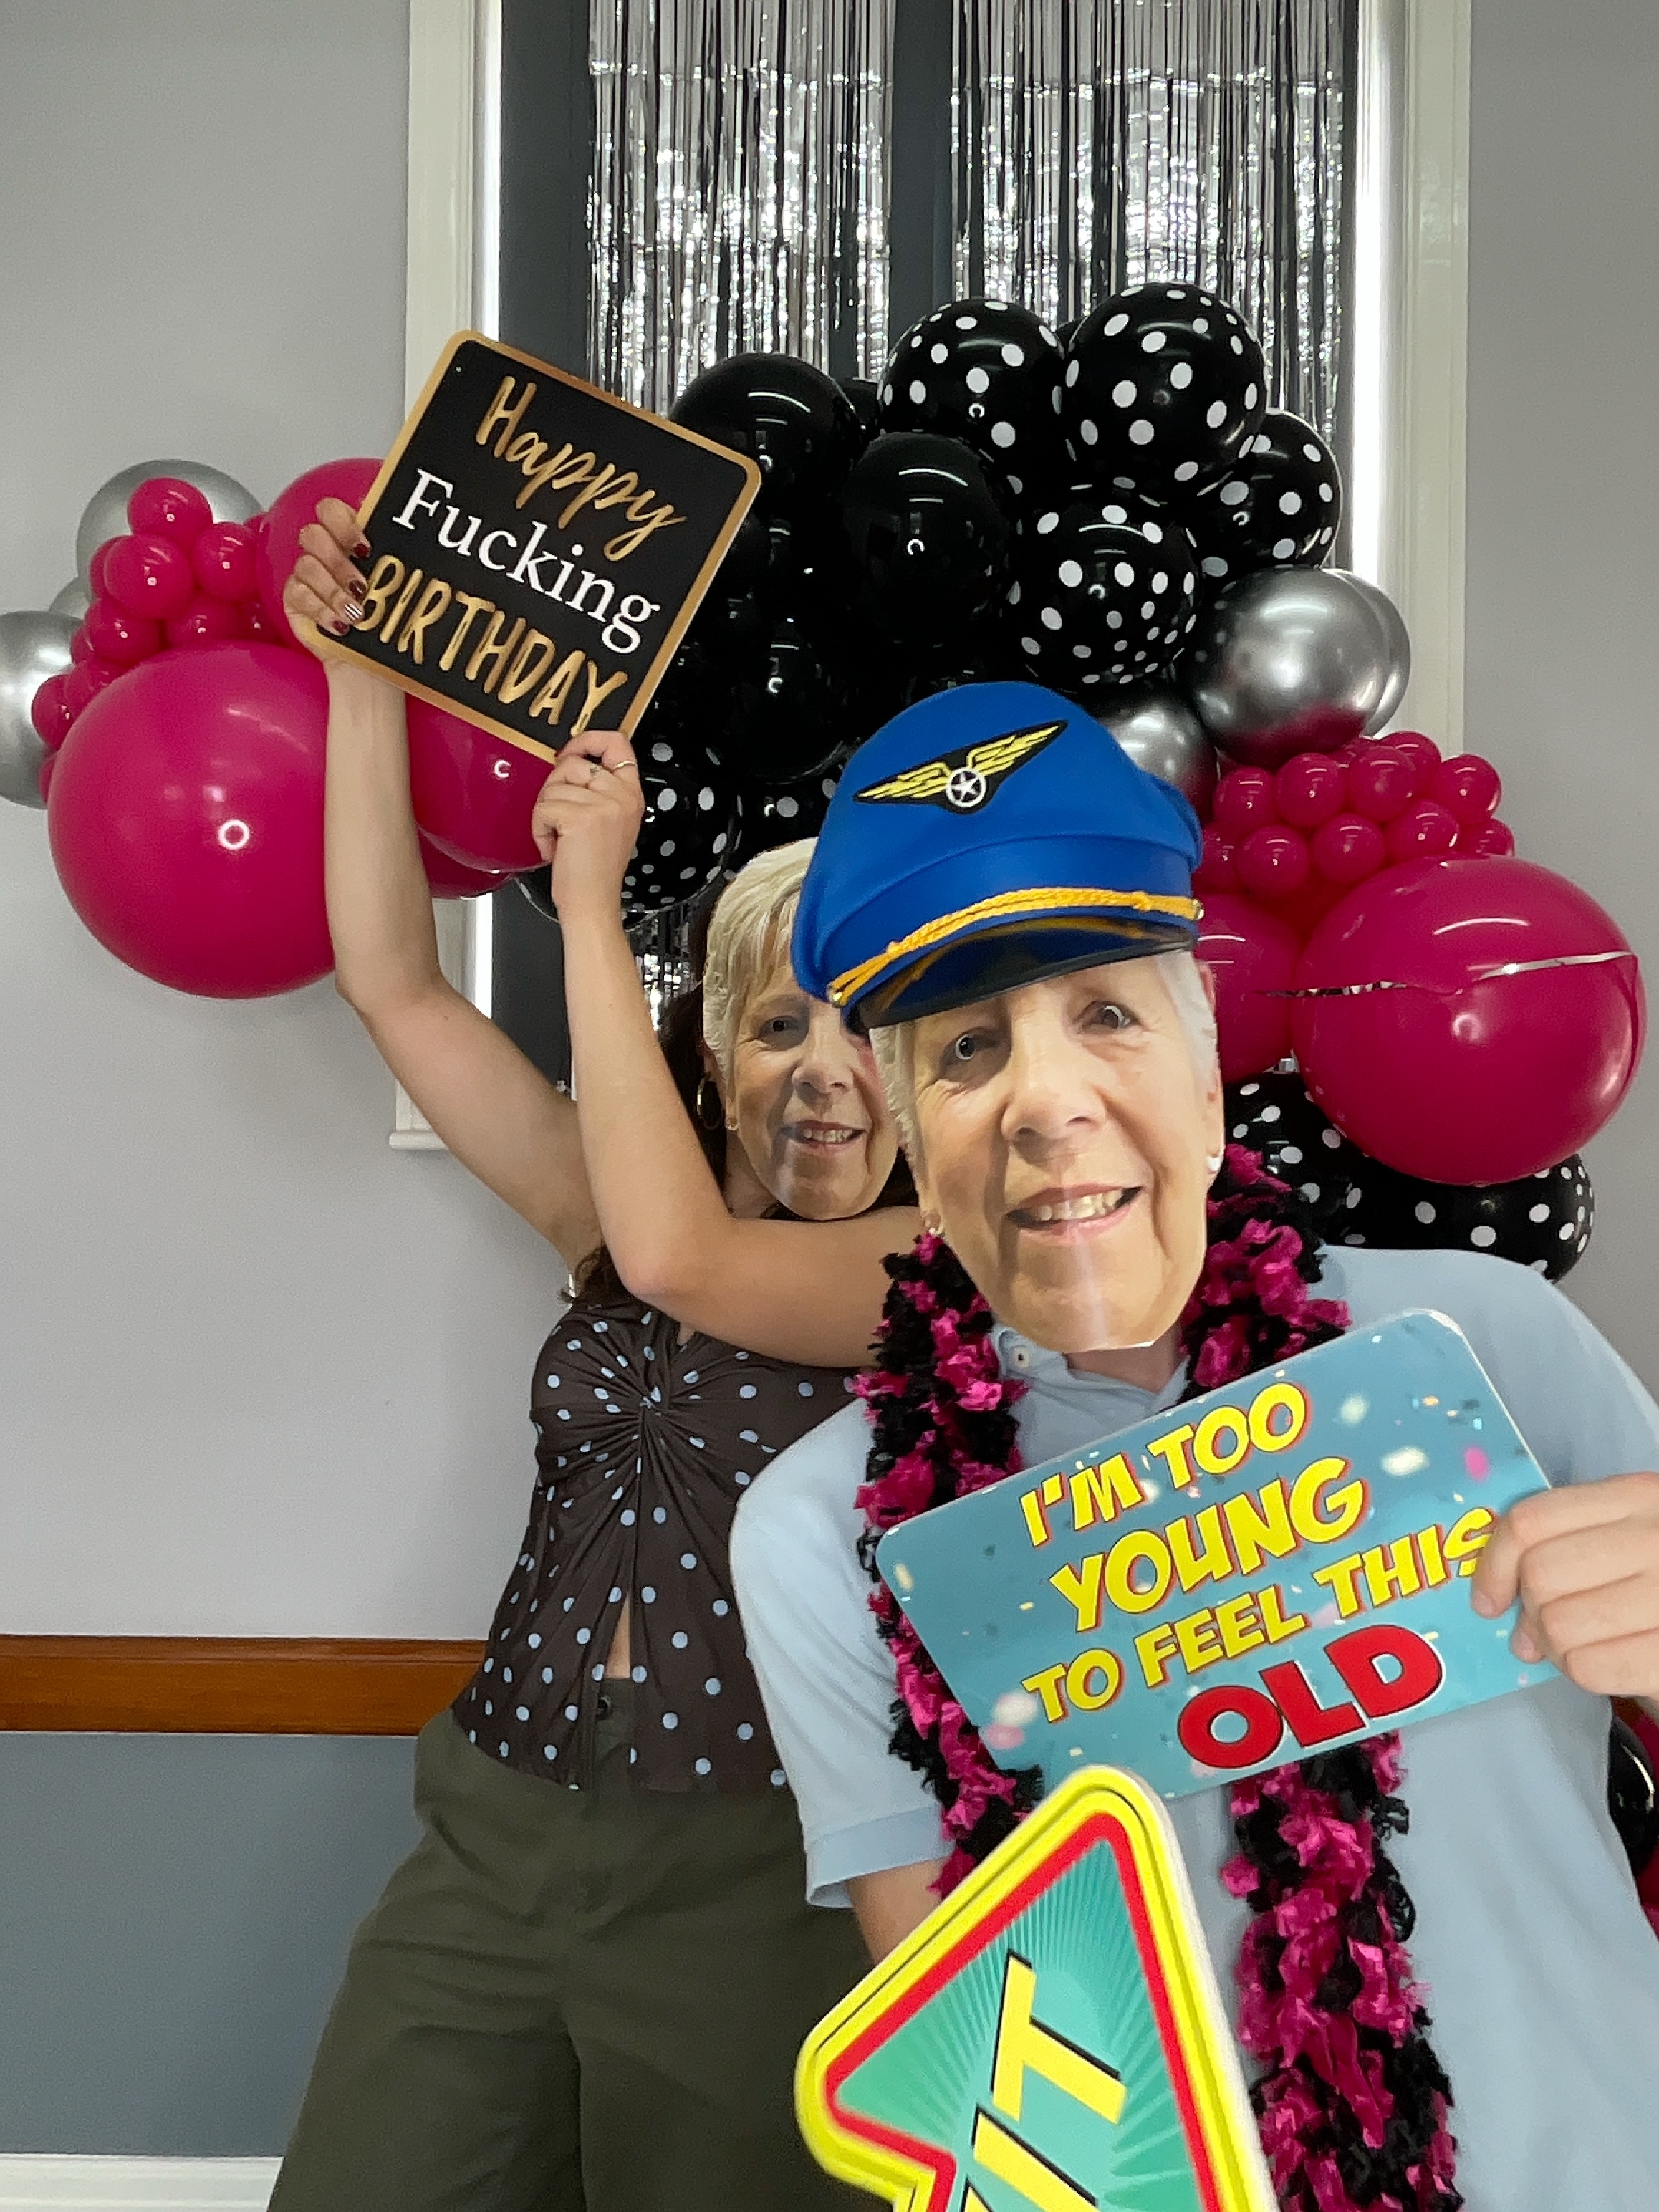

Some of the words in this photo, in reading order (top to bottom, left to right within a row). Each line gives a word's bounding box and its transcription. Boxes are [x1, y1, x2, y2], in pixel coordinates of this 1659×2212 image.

[475, 375, 687, 562] Happy
[353, 554, 627, 737] BIRTHDAY
[392, 468, 660, 653] Fucking
[1020, 1451, 1143, 1547] I'M
[1148, 1381, 1309, 1490] TOO
[1048, 1456, 1367, 1634] YOUNG
[1021, 1648, 1124, 1723] TO
[1133, 1585, 1307, 1688] FEEL
[1313, 1506, 1496, 1619] THIS
[1176, 1624, 1444, 1770] OLD
